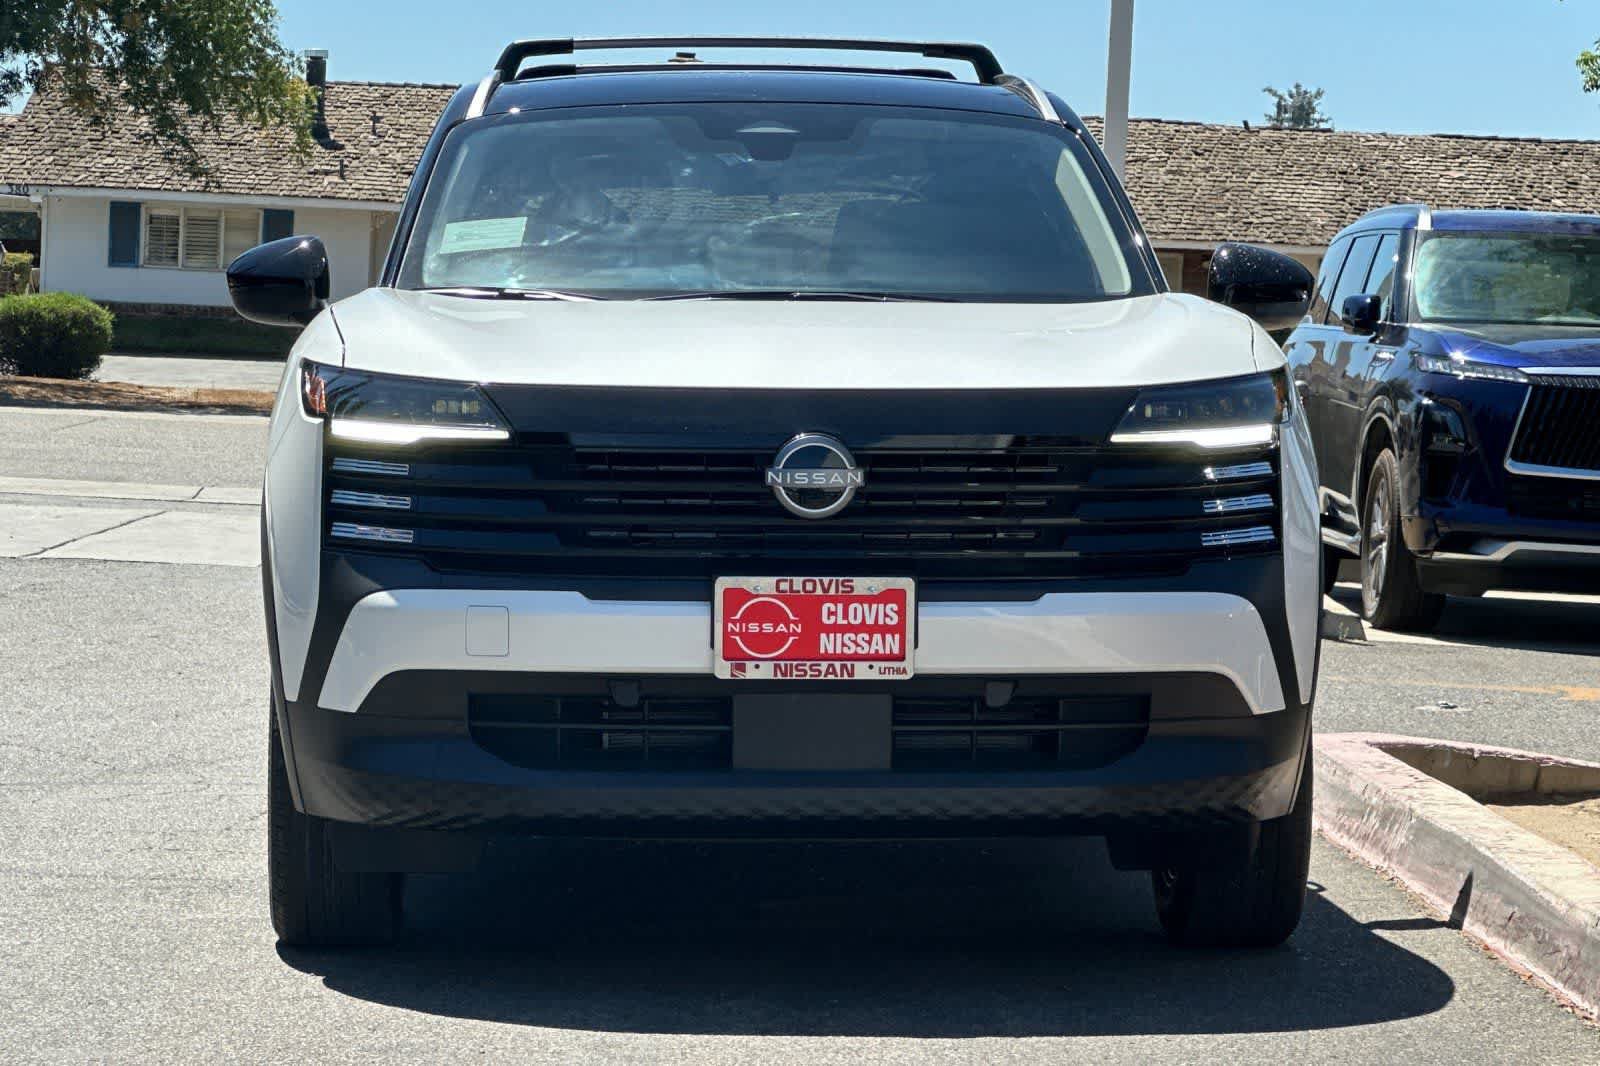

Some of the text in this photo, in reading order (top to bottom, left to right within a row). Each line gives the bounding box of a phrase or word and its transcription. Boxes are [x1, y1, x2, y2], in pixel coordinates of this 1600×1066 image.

[767, 471, 861, 484] NISSAN
[775, 578, 855, 594] CLOVIS
[821, 603, 899, 625] CLOVIS
[727, 622, 802, 633] NISSAN
[819, 632, 900, 655] NISSAN
[773, 663, 855, 678] NISSAN
[878, 666, 908, 676] LITHIA
